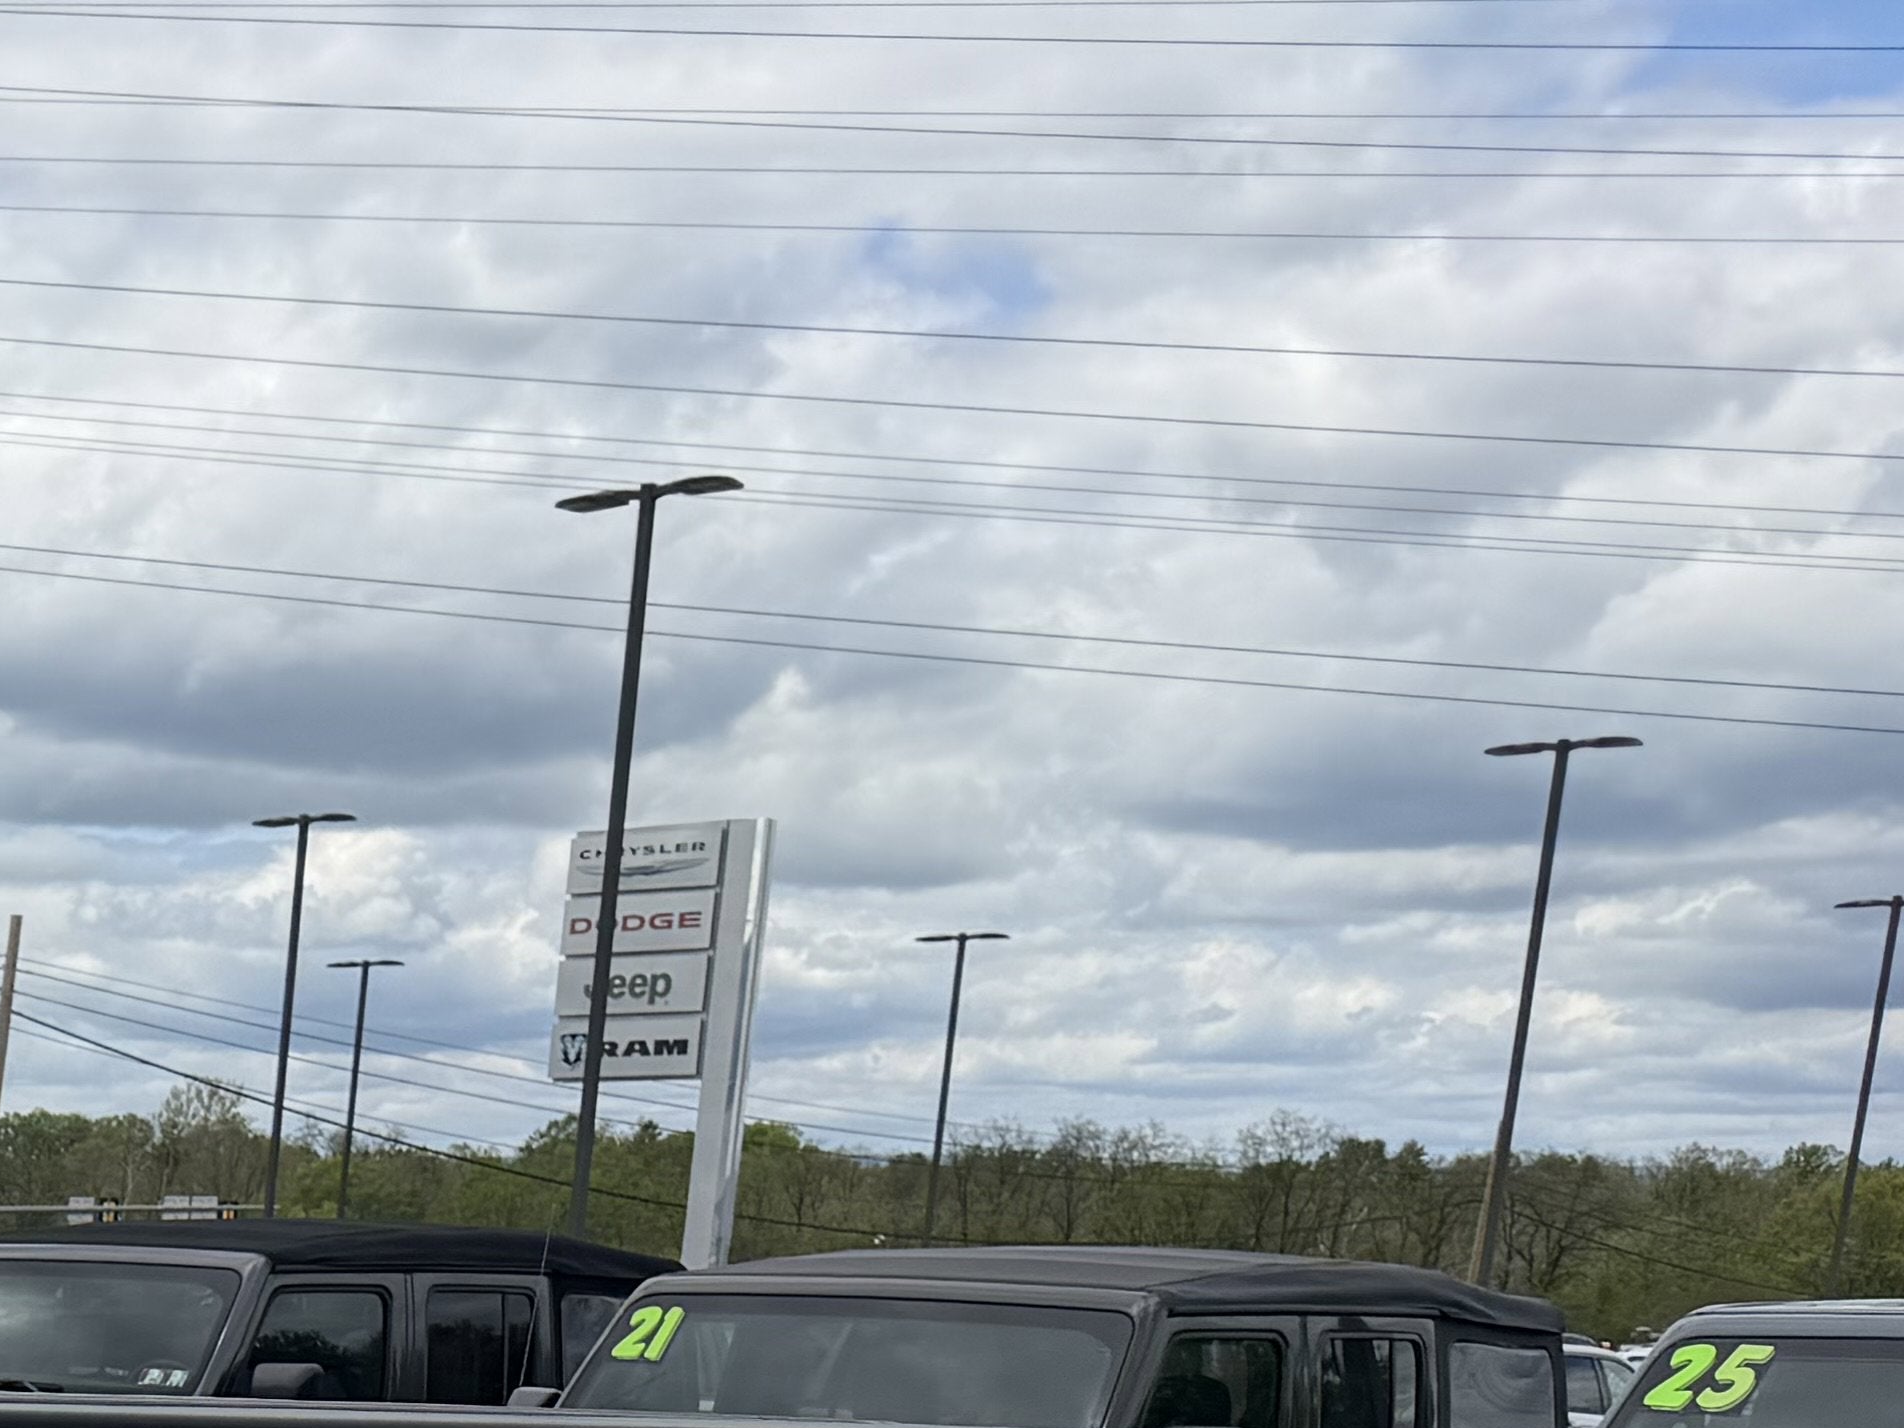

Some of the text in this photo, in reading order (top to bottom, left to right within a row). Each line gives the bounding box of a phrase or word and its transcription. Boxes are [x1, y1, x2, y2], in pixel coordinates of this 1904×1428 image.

[580, 842, 706, 859] CHYSLER
[569, 911, 702, 934] DDGE
[611, 1306, 685, 1361] 21
[1643, 1344, 1775, 1412] 25
